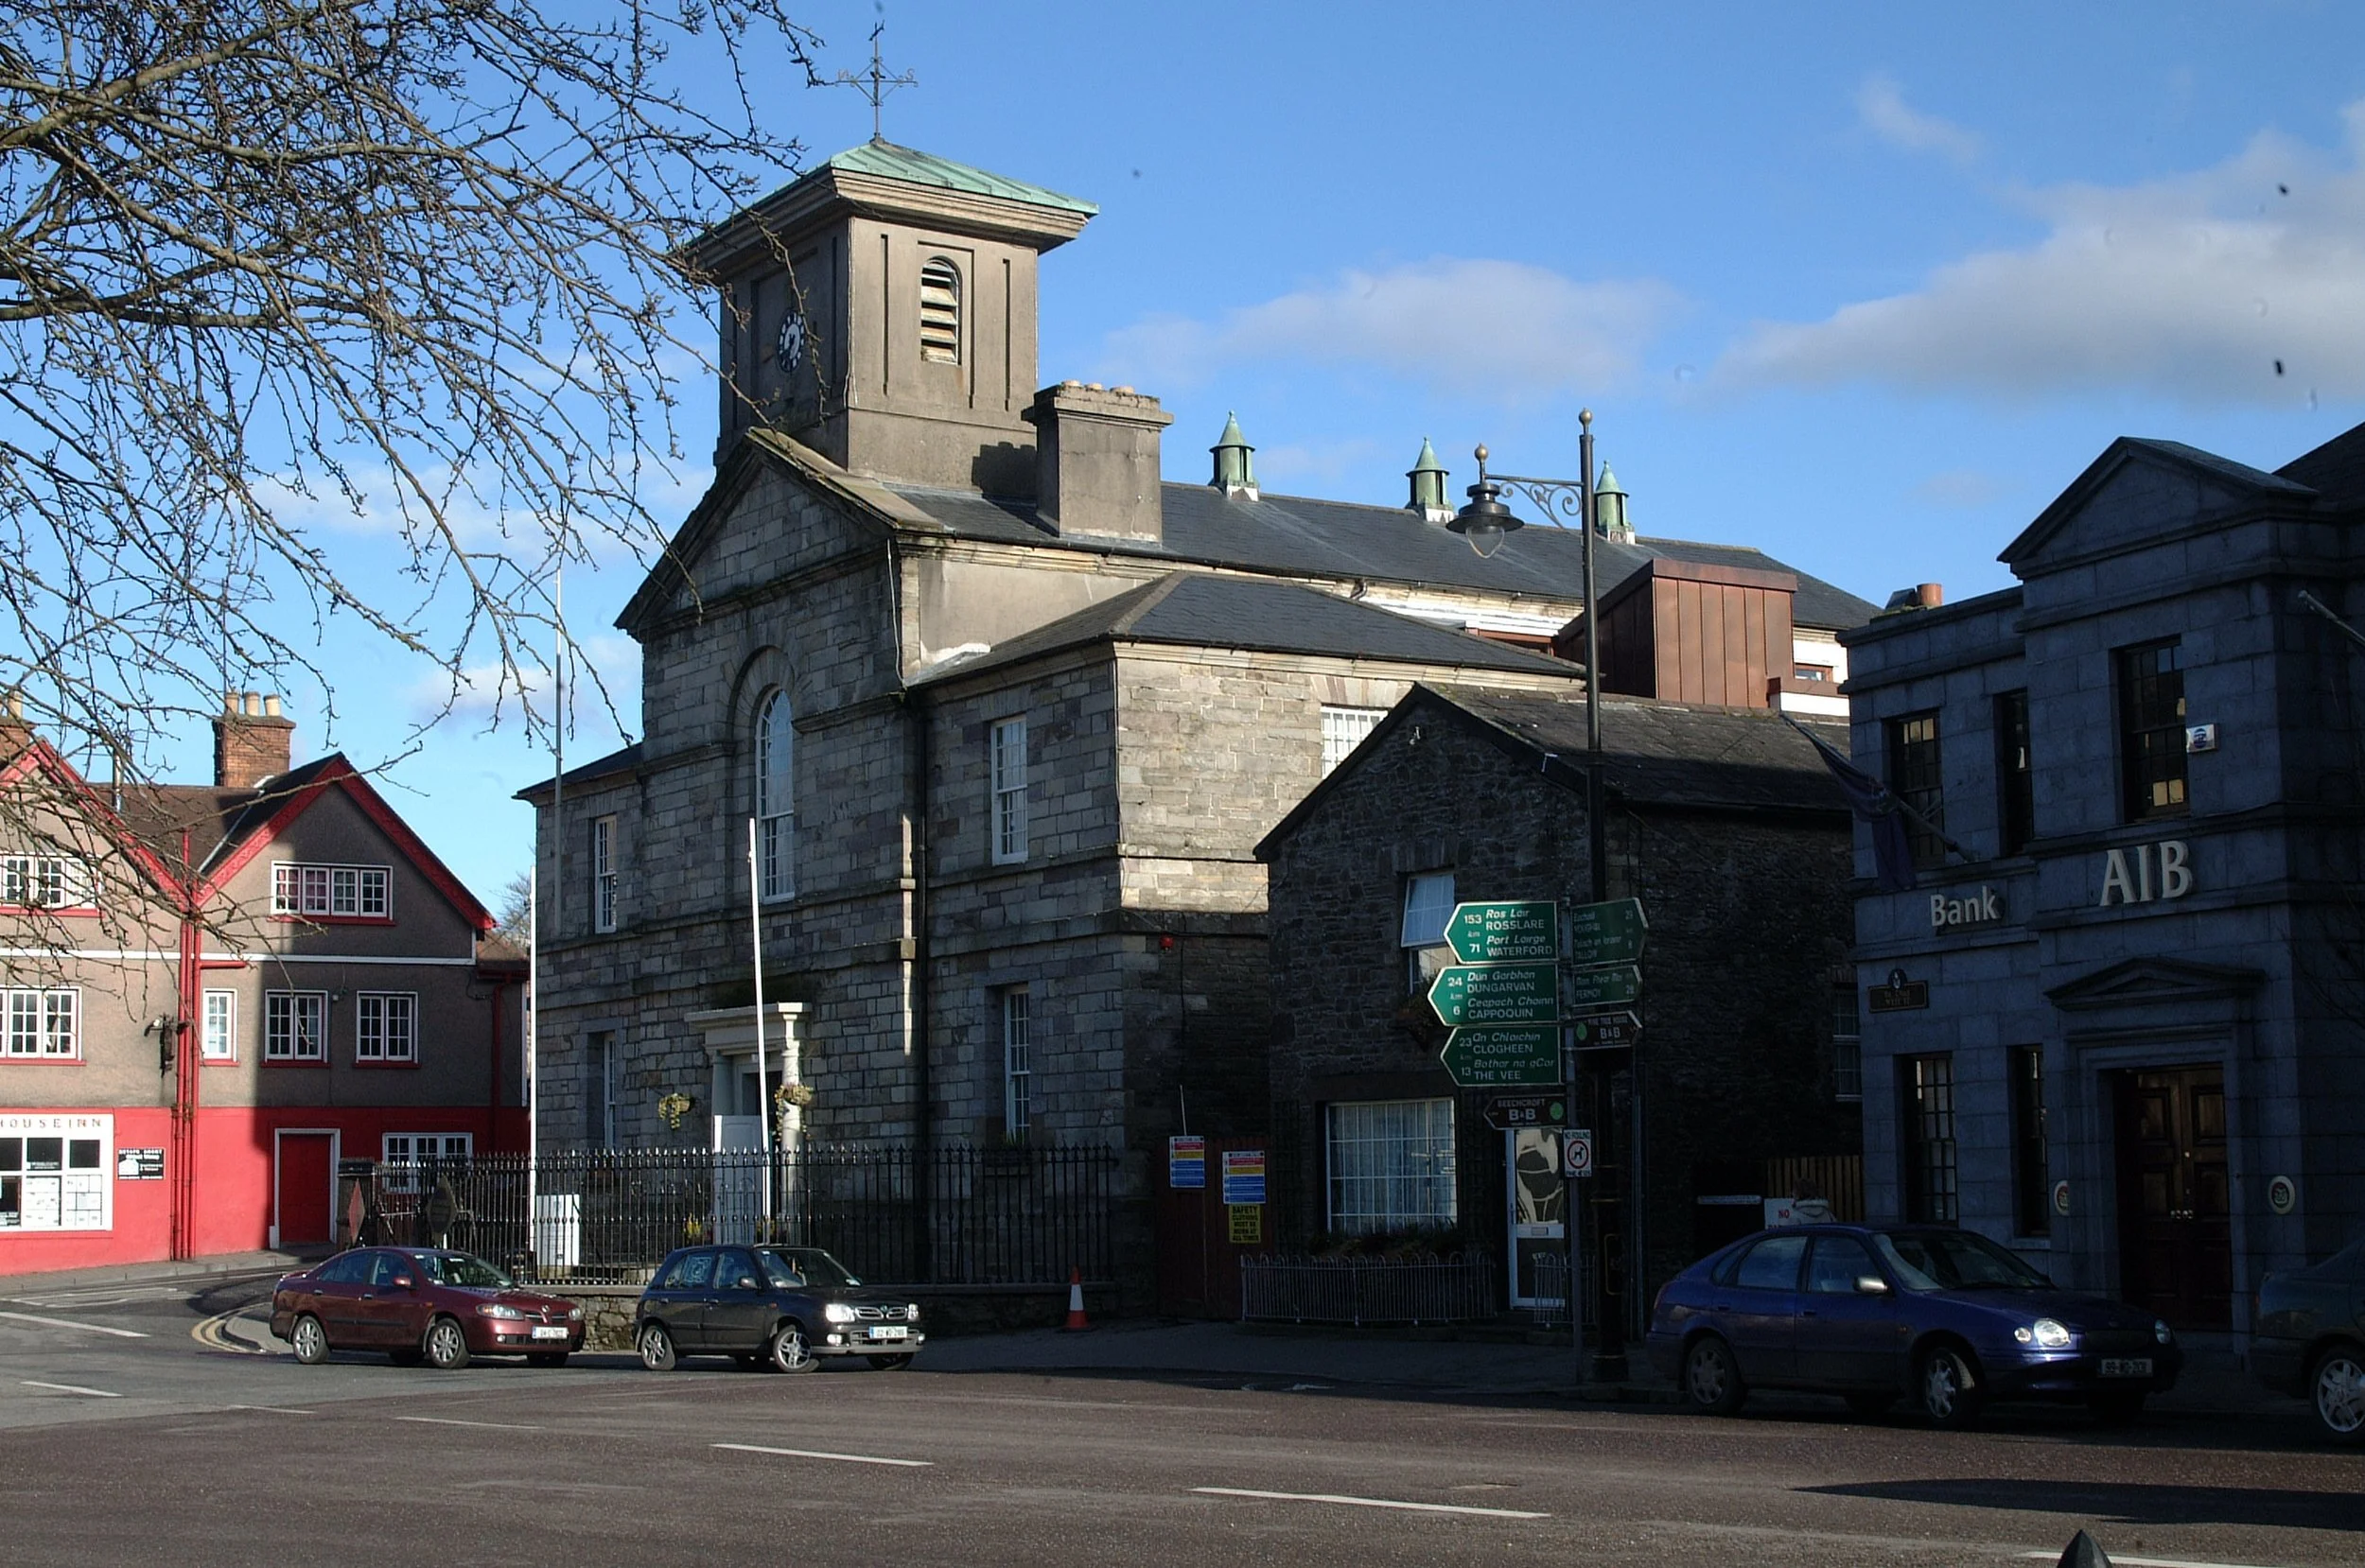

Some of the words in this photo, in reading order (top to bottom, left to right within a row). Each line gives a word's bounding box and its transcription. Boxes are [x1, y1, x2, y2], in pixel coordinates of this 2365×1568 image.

[2099, 841, 2193, 907] AIB
[1930, 885, 2003, 927] Bank
[1463, 914, 1482, 925] 153
[1485, 909, 1506, 919] Ros
[1485, 919, 1545, 931] ROSSLARE
[1467, 930, 1480, 938] km
[1486, 934, 1510, 946] Port
[1469, 944, 1480, 953] 71
[1486, 945, 1553, 957] WATERFORD
[1447, 976, 1463, 987] 24
[1466, 982, 1535, 994] DUNGARVAN
[1467, 997, 1514, 1009] Ceapach
[1453, 1005, 1461, 1016] 6
[1468, 1008, 1533, 1019] CAPPOQUIN
[1600, 1026, 1620, 1039] B&B
[1459, 1037, 1472, 1048] 23
[1473, 1043, 1533, 1054] CLOGHEEN
[1461, 1066, 1471, 1076] 13
[1474, 1070, 1495, 1081] THE
[1499, 1070, 1521, 1080] VEE
[1498, 1098, 1545, 1107] BEECHCROFT
[1508, 1107, 1536, 1122] B&B
[67, 1118, 101, 1128] INN
[1778, 1209, 1789, 1219] NO
